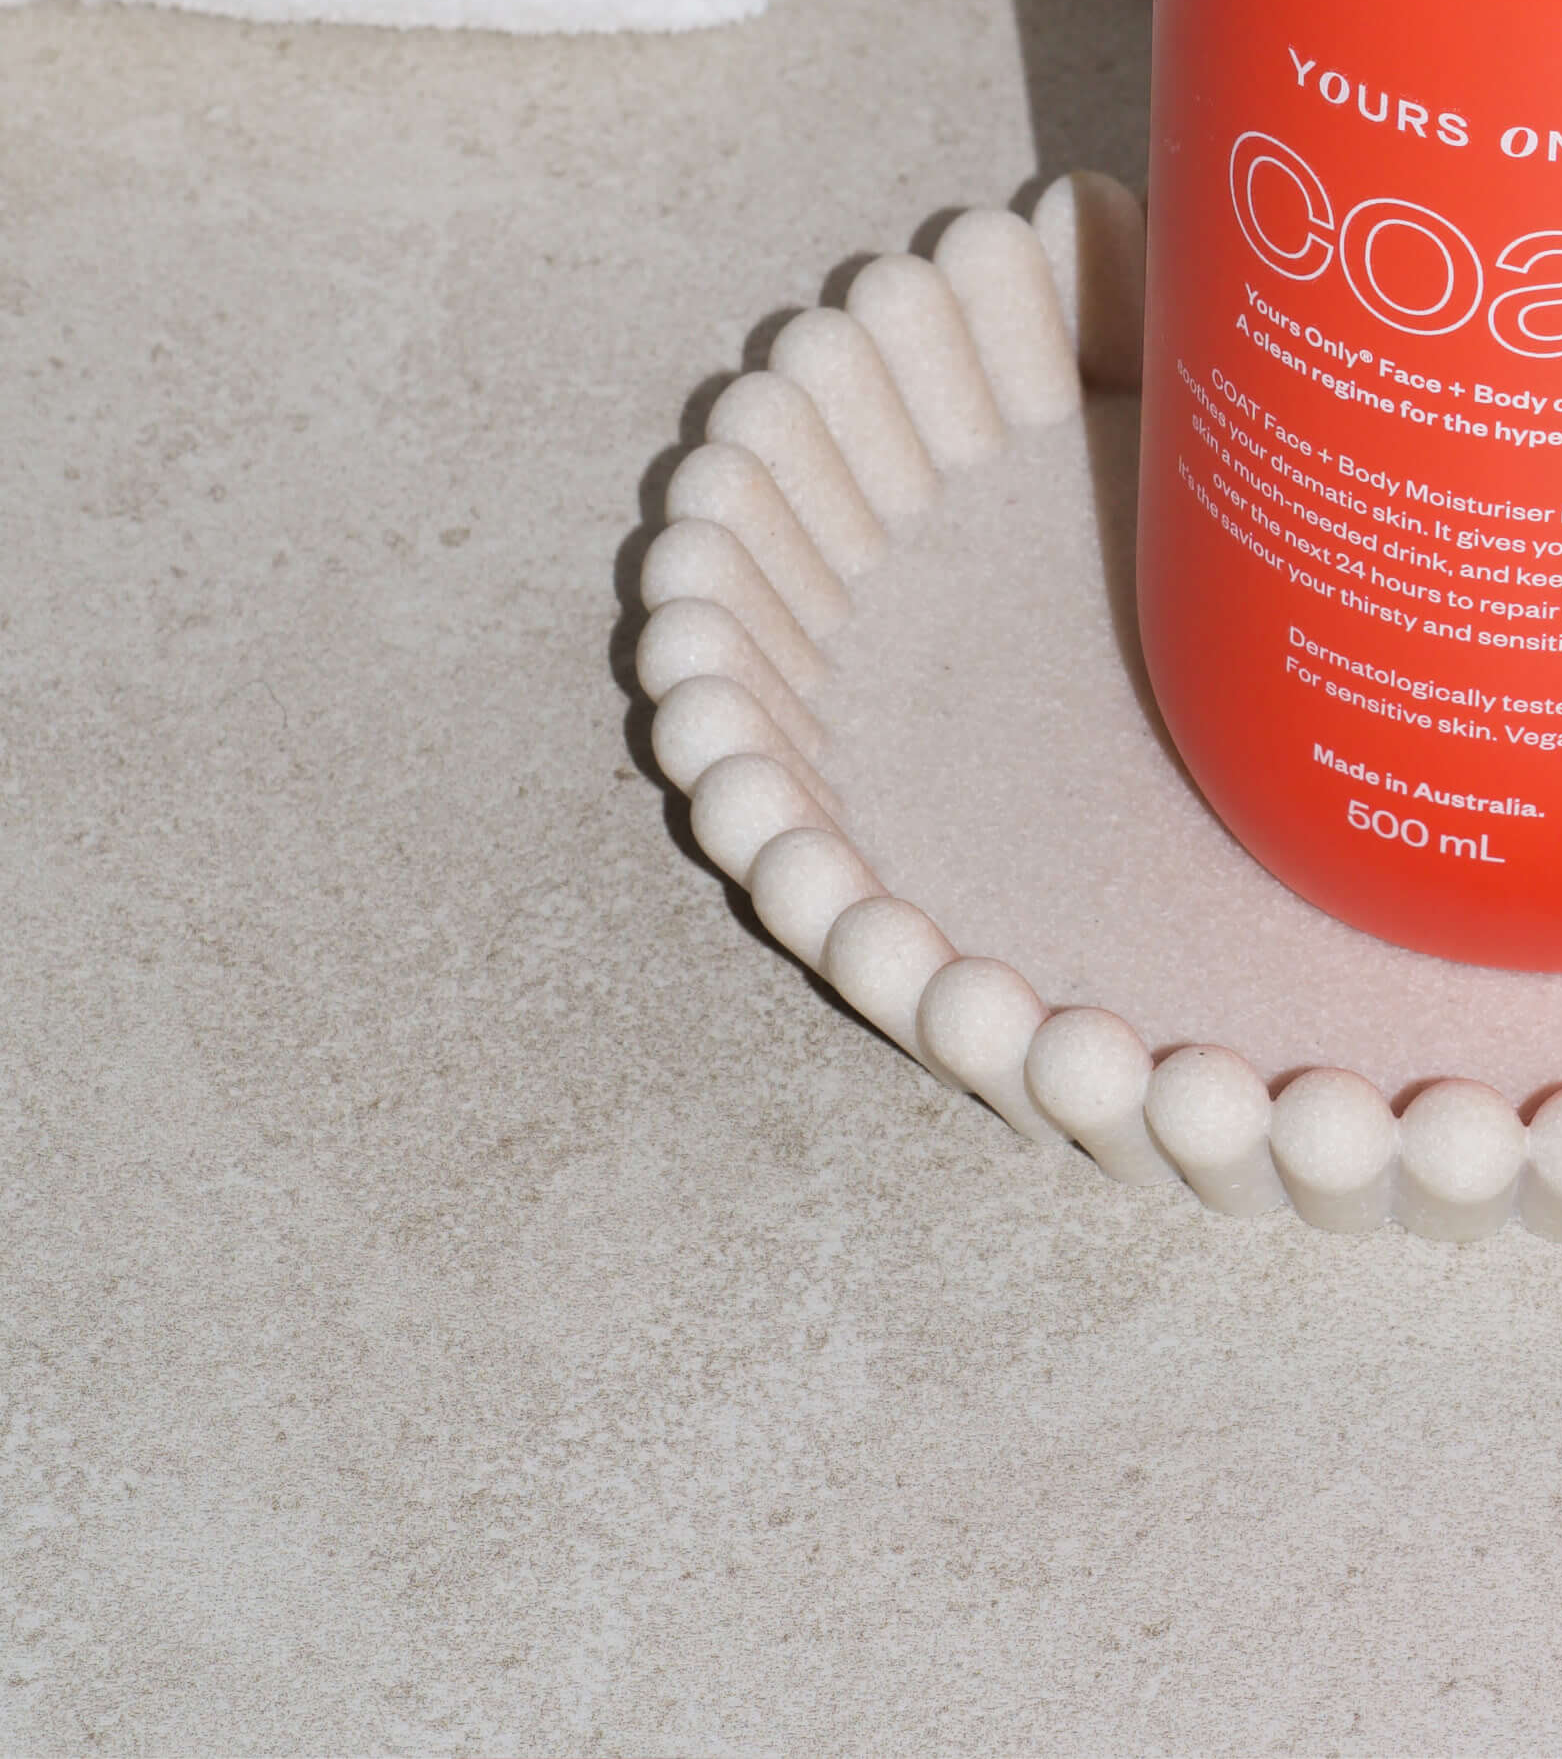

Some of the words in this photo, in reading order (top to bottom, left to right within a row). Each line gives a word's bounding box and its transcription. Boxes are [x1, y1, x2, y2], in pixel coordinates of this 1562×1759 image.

[1287, 43, 1470, 148] YOURS
[1235, 313, 1250, 338] A
[1252, 330, 1308, 376] clean
[1311, 366, 1396, 414] regime
[1399, 399, 1440, 426] for
[1442, 413, 1489, 438] the
[1244, 282, 1301, 338] Yours
[1378, 357, 1442, 394] Face
[1447, 381, 1466, 398] +
[1473, 383, 1549, 416] Body
[1177, 359, 1227, 429] soothes
[1229, 421, 1268, 460] your
[1270, 454, 1368, 515] dramatic
[1371, 505, 1429, 536] skin.
[1434, 520, 1452, 542] It
[1455, 527, 1527, 554] gives
[1192, 413, 1219, 454] skin
[1221, 448, 1231, 467] a
[1233, 459, 1378, 553] much-needed
[1382, 540, 1454, 578] drink,
[1459, 563, 1510, 584] and
[1211, 368, 1261, 421] COAT
[1264, 411, 1313, 457] Face
[1316, 447, 1334, 464] +
[1338, 454, 1401, 498] Body
[1405, 479, 1556, 523] Moisturiser
[1178, 455, 1195, 491] It's
[1196, 484, 1219, 519] the
[1221, 513, 1286, 571] saviour
[1287, 562, 1337, 599] your
[1339, 588, 1419, 633] thirsty
[1422, 620, 1473, 643] and
[1212, 473, 1249, 511] over
[1250, 503, 1282, 537] the
[1284, 529, 1332, 566] next
[1335, 552, 1367, 580] 24
[1370, 565, 1442, 604] hours
[1446, 590, 1474, 610] to
[1479, 598, 1561, 621] repair
[1285, 655, 1322, 688] For
[1324, 681, 1433, 729] sensitive
[1437, 716, 1498, 742] skin.
[1288, 625, 1497, 714] Dermatologically
[1313, 742, 1381, 786] Made
[1385, 772, 1408, 796] in
[1412, 781, 1545, 819] Australia.
[1346, 798, 1430, 848] 500
[1439, 833, 1506, 864] mL
